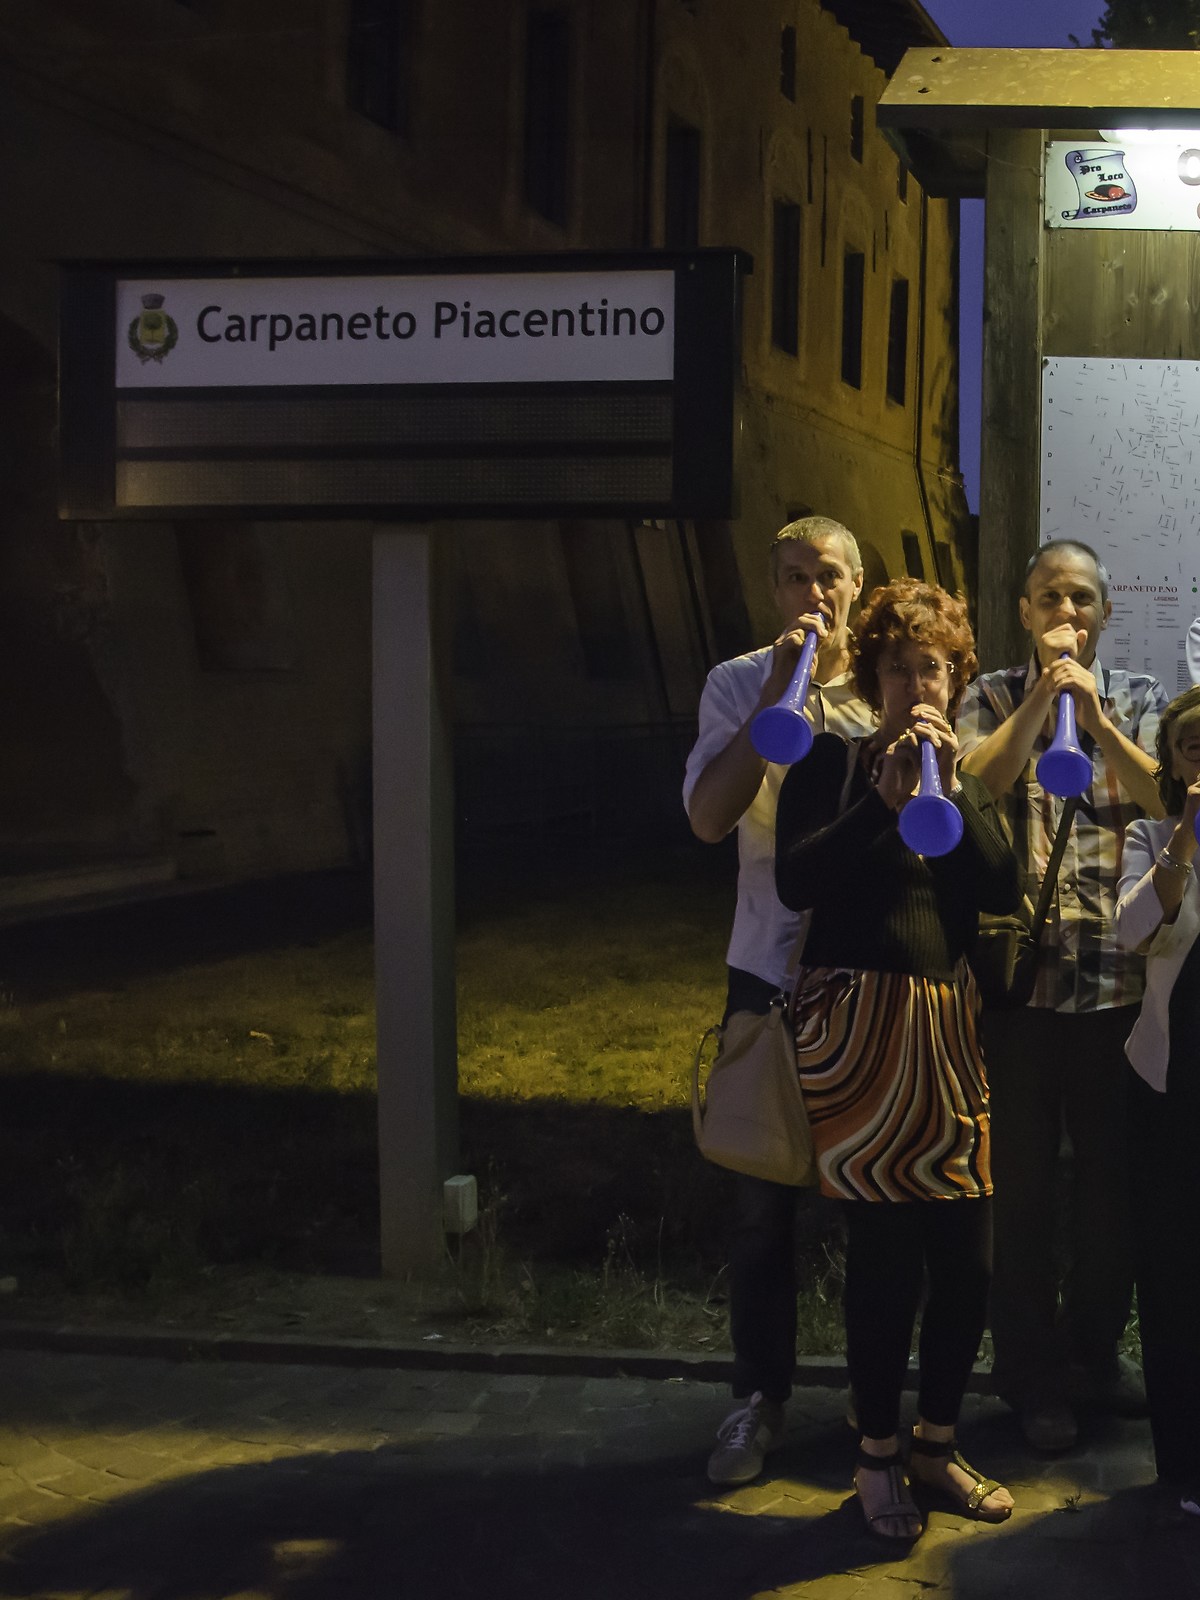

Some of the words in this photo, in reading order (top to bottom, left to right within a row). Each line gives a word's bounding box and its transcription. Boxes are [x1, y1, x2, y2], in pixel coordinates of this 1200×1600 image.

[1079, 165, 1101, 176] Pro
[1097, 173, 1124, 182] Loco
[1083, 204, 1132, 215] Carpaneto
[196, 304, 417, 351] Carpaneto
[434, 298, 665, 340] Piacentino
[1109, 585, 1157, 593] ARPANETO
